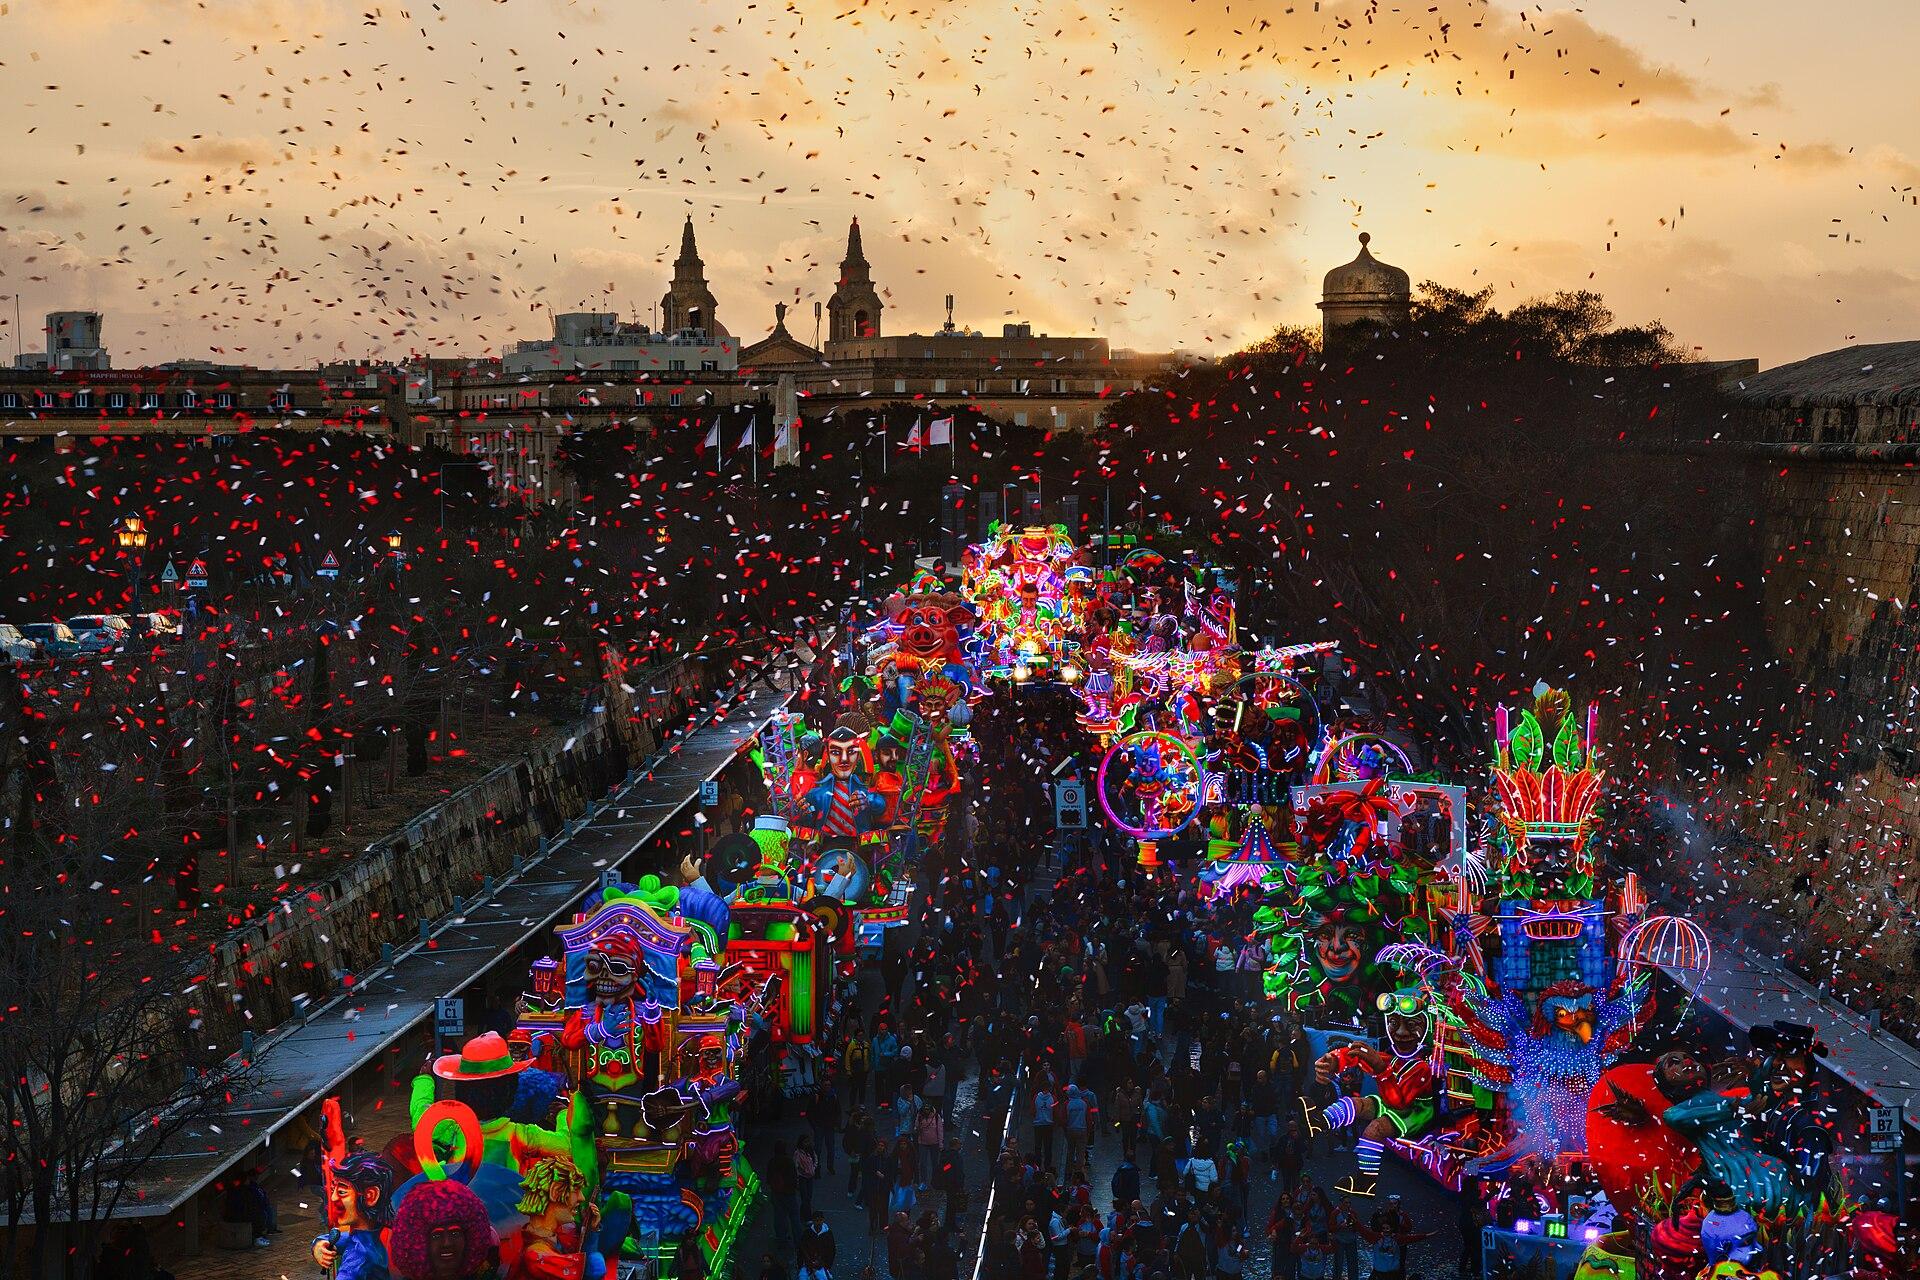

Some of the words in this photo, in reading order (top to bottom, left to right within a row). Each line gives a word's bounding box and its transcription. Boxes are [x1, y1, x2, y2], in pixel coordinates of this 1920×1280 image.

[1296, 791, 1304, 805] J
[1391, 785, 1401, 800] K
[445, 1009, 457, 1019] C1
[1877, 1109, 1892, 1117] BAY
[1877, 1119, 1893, 1132] B7
[1484, 1231, 1493, 1247] 31
